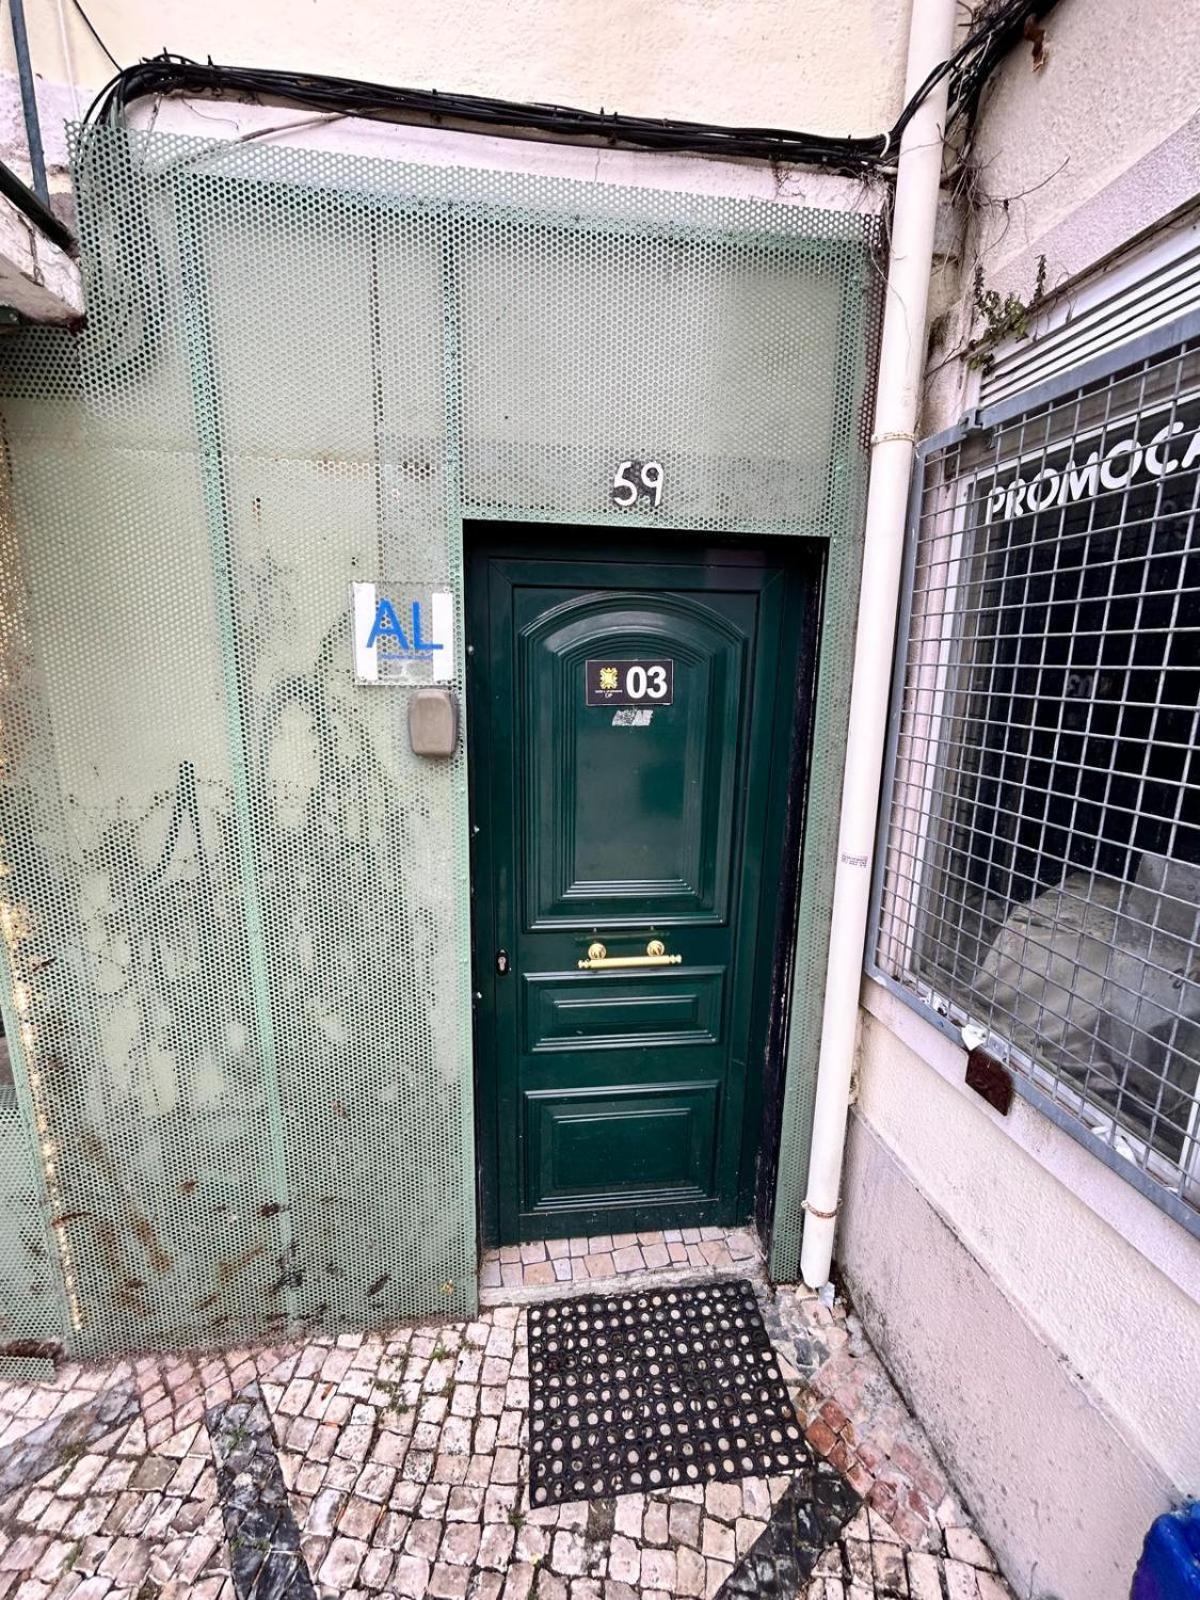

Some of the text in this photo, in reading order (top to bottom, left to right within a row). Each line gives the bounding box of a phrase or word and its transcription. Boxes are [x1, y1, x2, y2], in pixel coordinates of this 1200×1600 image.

[613, 461, 663, 507] 59
[366, 597, 444, 652] AL
[626, 665, 668, 699] 03
